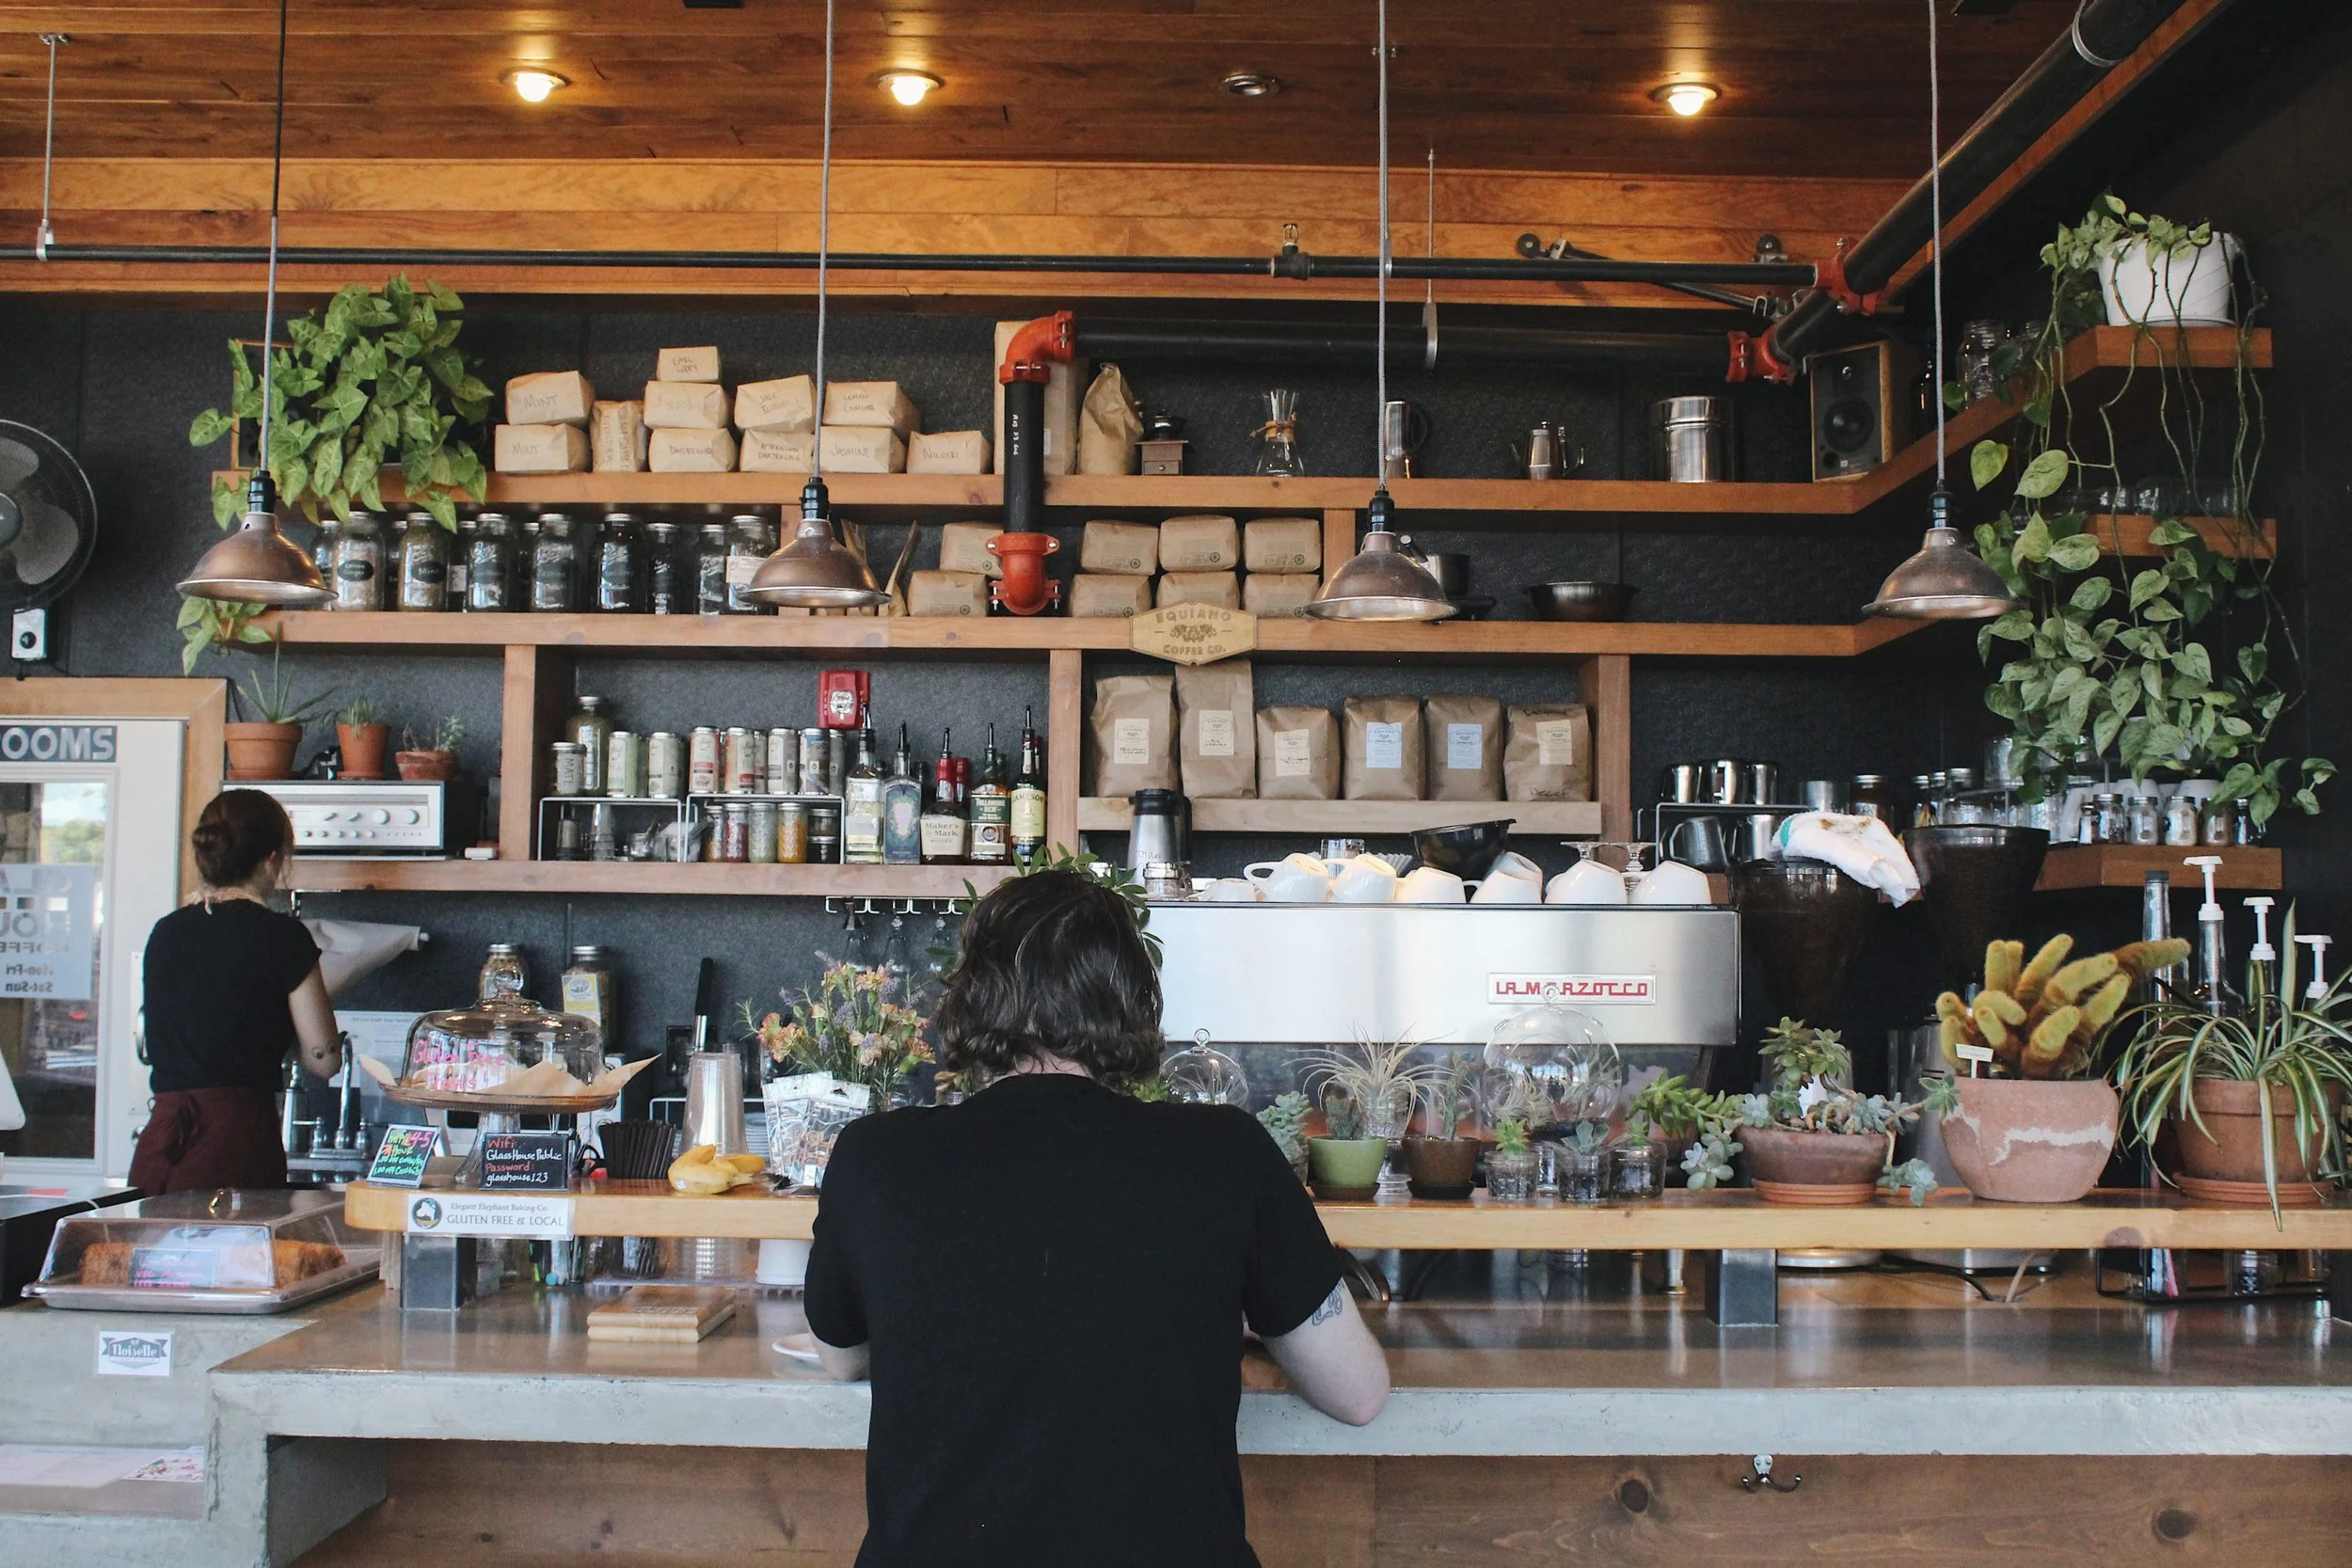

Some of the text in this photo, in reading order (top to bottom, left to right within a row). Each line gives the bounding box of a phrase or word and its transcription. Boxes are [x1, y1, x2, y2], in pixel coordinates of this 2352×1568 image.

[523, 393, 558, 409] MINT
[512, 443, 541, 455] MINT
[830, 443, 870, 458] JASMINE
[923, 447, 959, 460] NILGIRI
[1155, 609, 1232, 624] EQUIANO
[1163, 643, 1227, 656] COFFEE CO.
[485, 1171, 548, 1187] glasshouse123
[451, 1202, 477, 1212] Elegant
[478, 1203, 509, 1212] Elephant
[511, 1204, 535, 1212] Baking
[447, 1214, 488, 1225] GLUTEN
[491, 1215, 514, 1225] FREE
[530, 1216, 564, 1227] LOCAL
